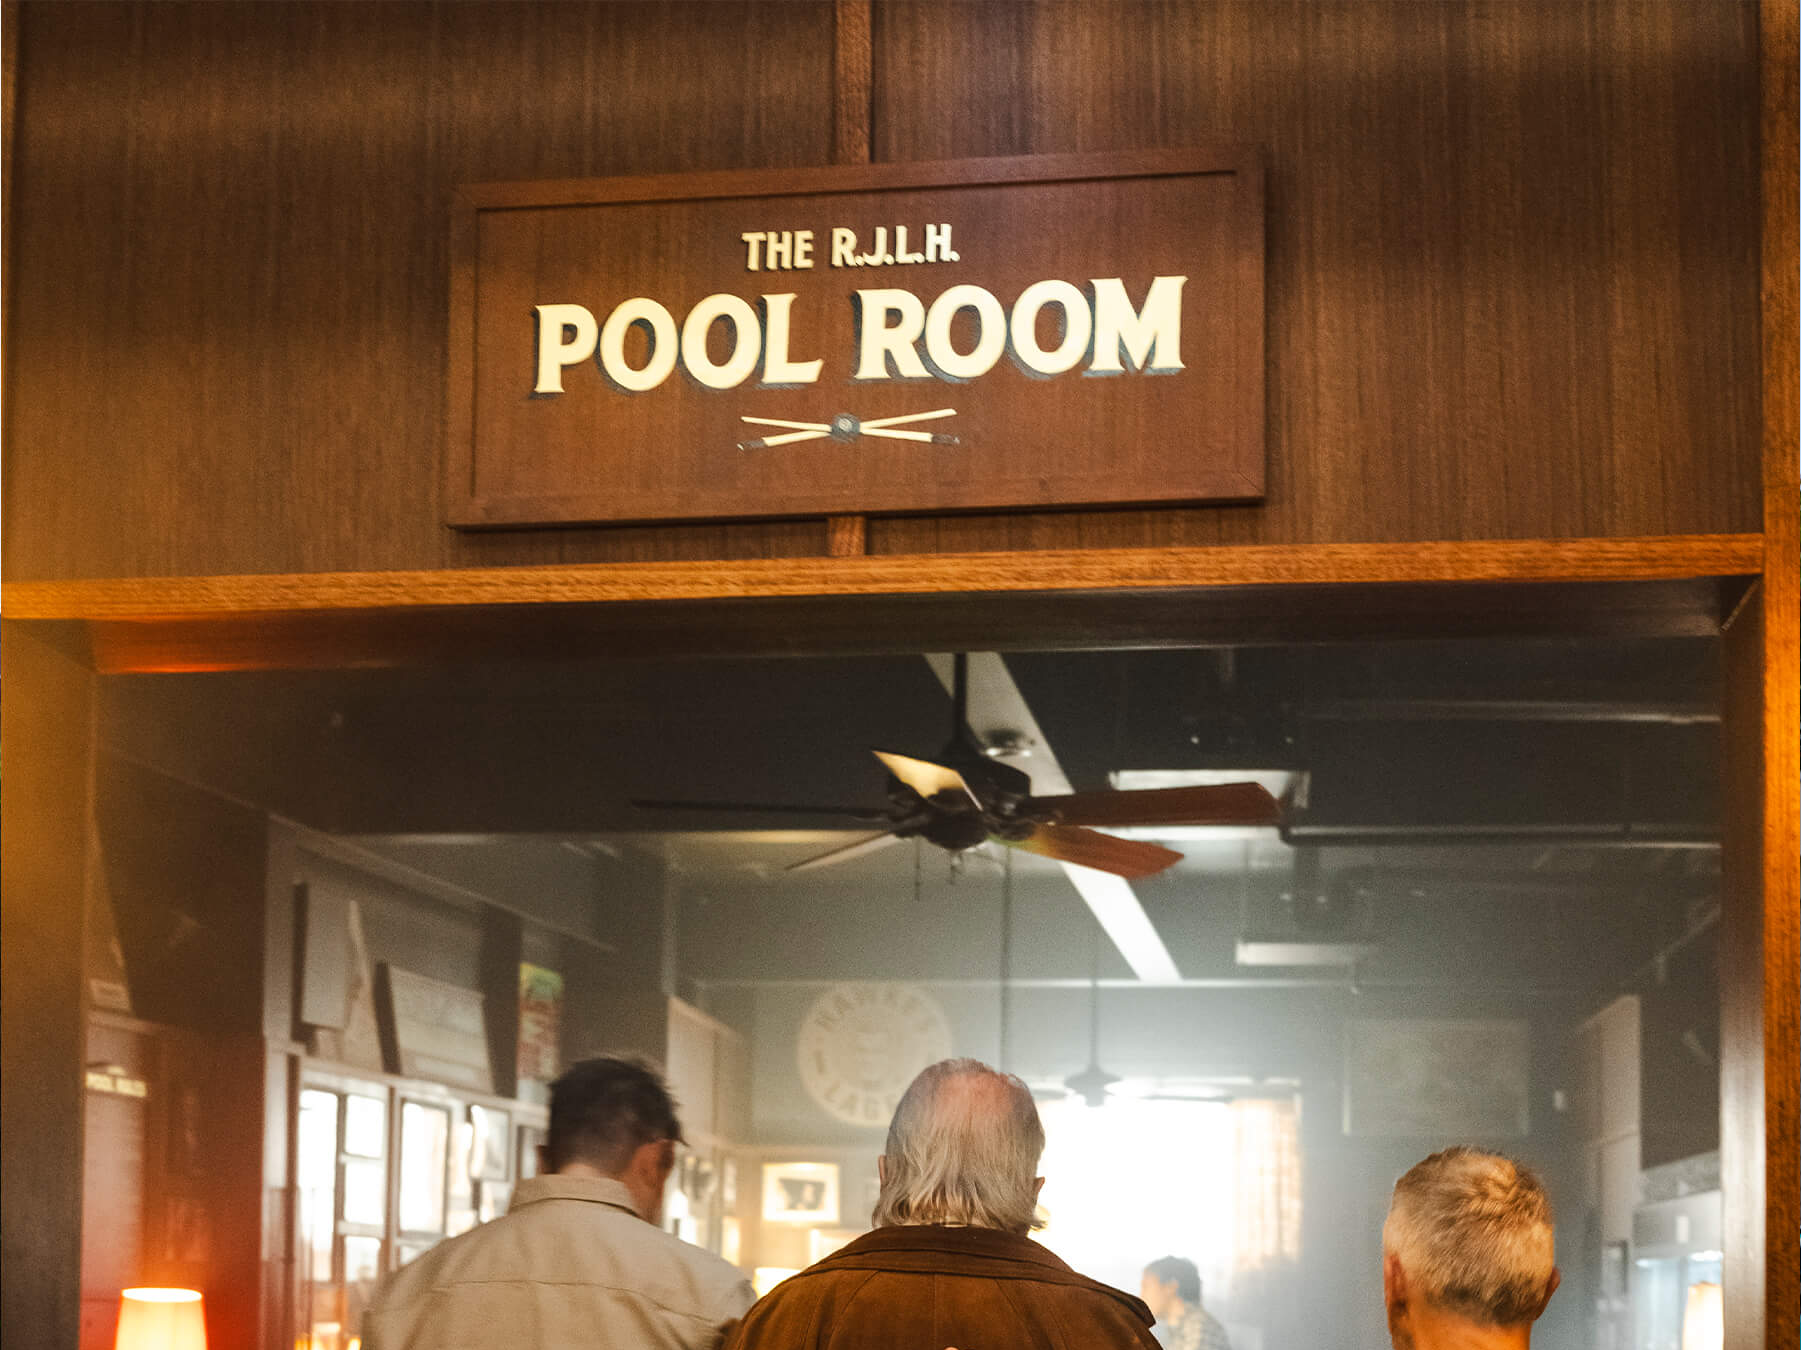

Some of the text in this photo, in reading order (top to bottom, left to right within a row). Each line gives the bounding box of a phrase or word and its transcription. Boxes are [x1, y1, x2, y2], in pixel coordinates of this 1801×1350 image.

[741, 223, 961, 271] THE R.J.L.H.
[535, 275, 1189, 393] POOL ROOM
